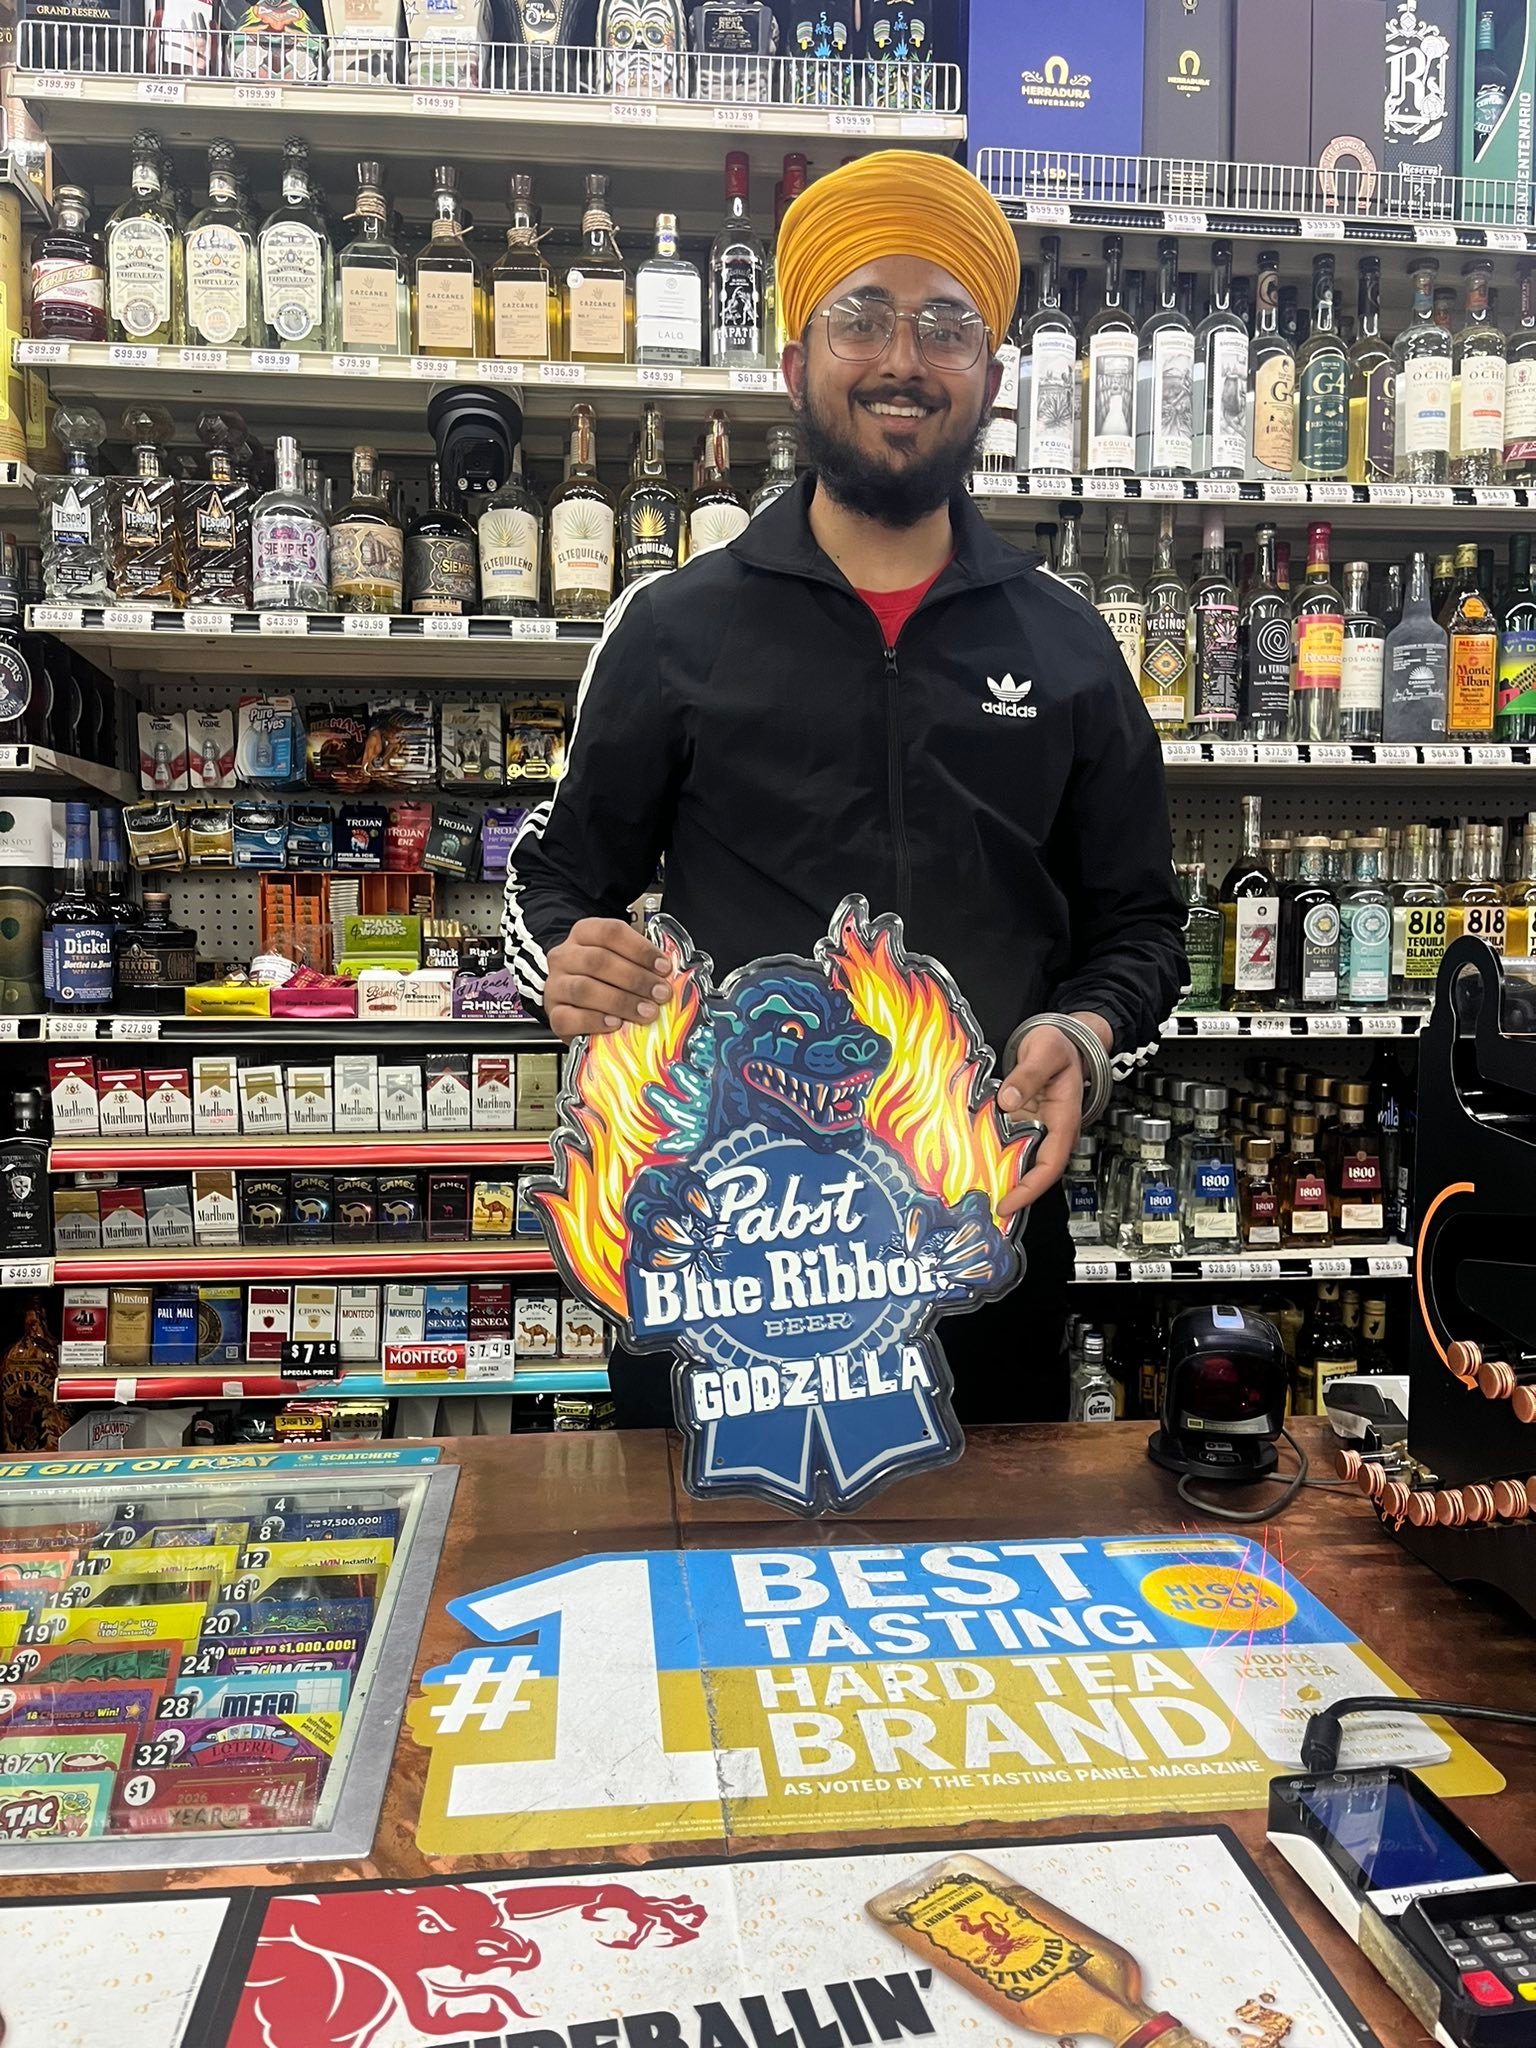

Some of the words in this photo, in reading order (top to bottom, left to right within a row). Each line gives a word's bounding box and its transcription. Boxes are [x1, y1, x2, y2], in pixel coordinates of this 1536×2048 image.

[37, 8, 67, 17] GRAND
[70, 8, 110, 19] RESERVA
[37, 79, 76, 89] $199.99
[1168, 77, 1210, 86] HERRADURA
[145, 85, 178, 95] $74.99
[238, 89, 276, 99] $199.99
[1022, 86, 1090, 99] HERRADURA
[1028, 98, 1084, 108] ANIVERSARIO
[614, 106, 652, 116] $249.99
[835, 116, 870, 126] $199.99
[1030, 206, 1064, 214] $599.99
[194, 278, 239, 286] FORTALEZA
[658, 331, 684, 340] LALO
[27, 345, 61, 356] $89.99
[114, 349, 147, 359] $99.99
[183, 353, 222, 363] $149.99
[544, 367, 579, 376] $136.99
[643, 371, 674, 381] $49.99
[738, 374, 767, 382] $61.99
[1313, 373, 1346, 395] G4
[1091, 481, 1120, 490] $89.99
[1204, 485, 1236, 494] $121.99
[56, 510, 86, 524] TESORO
[126, 511, 156, 525] TESORO
[201, 516, 231, 530] TESORO
[264, 543, 308, 558] SIEMPRE
[39, 611, 73, 621] $54.99
[111, 613, 143, 623] $69.99
[190, 616, 222, 625] $89.99
[520, 625, 550, 633] $54.99
[1147, 619, 1185, 630] VECINOS
[1456, 665, 1491, 676] Monte
[1457, 676, 1489, 686] Alban
[250, 708, 274, 721] Pure
[982, 702, 1037, 717] adidas
[150, 721, 172, 731] VISINE
[198, 719, 221, 728] VISINE
[262, 719, 285, 731] Eyes
[131, 815, 169, 827] ChapStick
[346, 819, 382, 827] TROJAN
[438, 818, 473, 833] TROJAN
[387, 827, 424, 838] TROJAN
[398, 839, 414, 847] ENZ
[426, 853, 462, 866] BARESKIN
[1408, 910, 1446, 935] 818
[1467, 909, 1504, 933] 818
[75, 930, 104, 939] GEORGE
[64, 938, 110, 955] Dickel
[1250, 928, 1270, 962] 2
[1408, 937, 1445, 947] TEQUILA
[429, 949, 458, 957] Black
[1407, 947, 1445, 957] BLANCO
[120, 962, 156, 971] SEXTON
[435, 957, 459, 967] Mild
[55, 1023, 87, 1032] $89.99
[121, 1024, 152, 1033] $27.99
[1257, 1021, 1284, 1030] $57.99
[1314, 1020, 1342, 1029] $54.99
[1369, 1020, 1396, 1029] $49.99
[199, 1101, 233, 1116] Marlboro
[150, 1106, 189, 1124] Marlboro
[1348, 1167, 1375, 1178] 1800
[337, 1177, 373, 1192] CAMEL
[433, 1182, 465, 1190] CAMEL
[1202, 1175, 1229, 1188] 1800
[247, 1183, 284, 1195] CAMEL
[705, 1165, 866, 1249] Pabst
[9, 1268, 42, 1278] $49.99
[1085, 1265, 1109, 1275] $9.99
[1138, 1263, 1166, 1274] $15.99
[113, 1292, 149, 1304] Winston
[640, 1260, 763, 1327] Blue
[158, 1307, 173, 1318] PALL
[176, 1307, 194, 1318] MALL
[252, 1308, 285, 1316] CROWNS
[342, 1310, 374, 1319] MONTEGO
[389, 1309, 421, 1318] MONTEGO
[428, 1319, 466, 1328] SENECA
[471, 1316, 509, 1326] SENECA
[765, 1312, 854, 1338] BEER
[390, 1350, 457, 1364] MONTEGO
[693, 1345, 932, 1422] GODZILLA
[320, 1452, 400, 1460] SCRATCHERS
[39, 1462, 124, 1476] GIFT
[131, 1458, 180, 1472] OF
[274, 1498, 286, 1511] 4
[124, 1506, 135, 1518] 3
[322, 1516, 382, 1526] $7,500,000!
[259, 1526, 271, 1540] 8
[103, 1533, 115, 1548] 7
[241, 1553, 263, 1568] 12
[76, 1560, 97, 1576] 11
[731, 1543, 1093, 1613] BEST
[222, 1584, 246, 1600] 16
[1163, 1582, 1259, 1597] HIGH
[51, 1593, 73, 1608] 15
[1172, 1596, 1279, 1611] NOON
[100, 1622, 117, 1630] Find
[140, 1620, 157, 1629] Win
[204, 1616, 231, 1635] 20
[25, 1626, 49, 1642] 19
[745, 1604, 1158, 1659] TASTING
[228, 1647, 246, 1655] WIN
[250, 1646, 263, 1654] UP
[265, 1646, 276, 1654] TO
[182, 1656, 211, 1675] 24
[1234, 1654, 1317, 1666] VODKA
[1236, 1667, 1288, 1679] ICED
[1292, 1666, 1340, 1678] TEA
[756, 1659, 995, 1708] HARD
[1014, 1653, 1194, 1697] TEA
[159, 1698, 189, 1717] 28
[221, 1693, 298, 1718] MEGA
[26, 1711, 38, 1720] 18
[39, 1711, 81, 1720] Chances
[98, 1708, 119, 1717] Win!
[767, 1696, 1232, 1778] BRAND
[212, 1742, 274, 1757] LOTERIA
[137, 1745, 167, 1766] 32
[784, 1783, 813, 1795] AS
[818, 1779, 891, 1794] VOTED
[896, 1776, 923, 1792] BY
[929, 1774, 975, 1789] THE
[980, 1770, 1074, 1787] TASTING
[1076, 1765, 1147, 1783] PANEL
[1151, 1760, 1265, 1778] MAGAZINE
[129, 1782, 148, 1799] $1
[6, 1801, 53, 1828] TAC
[990, 1938, 1063, 1984] FIREBALL
[424, 1968, 934, 2048] EBALLIN'
